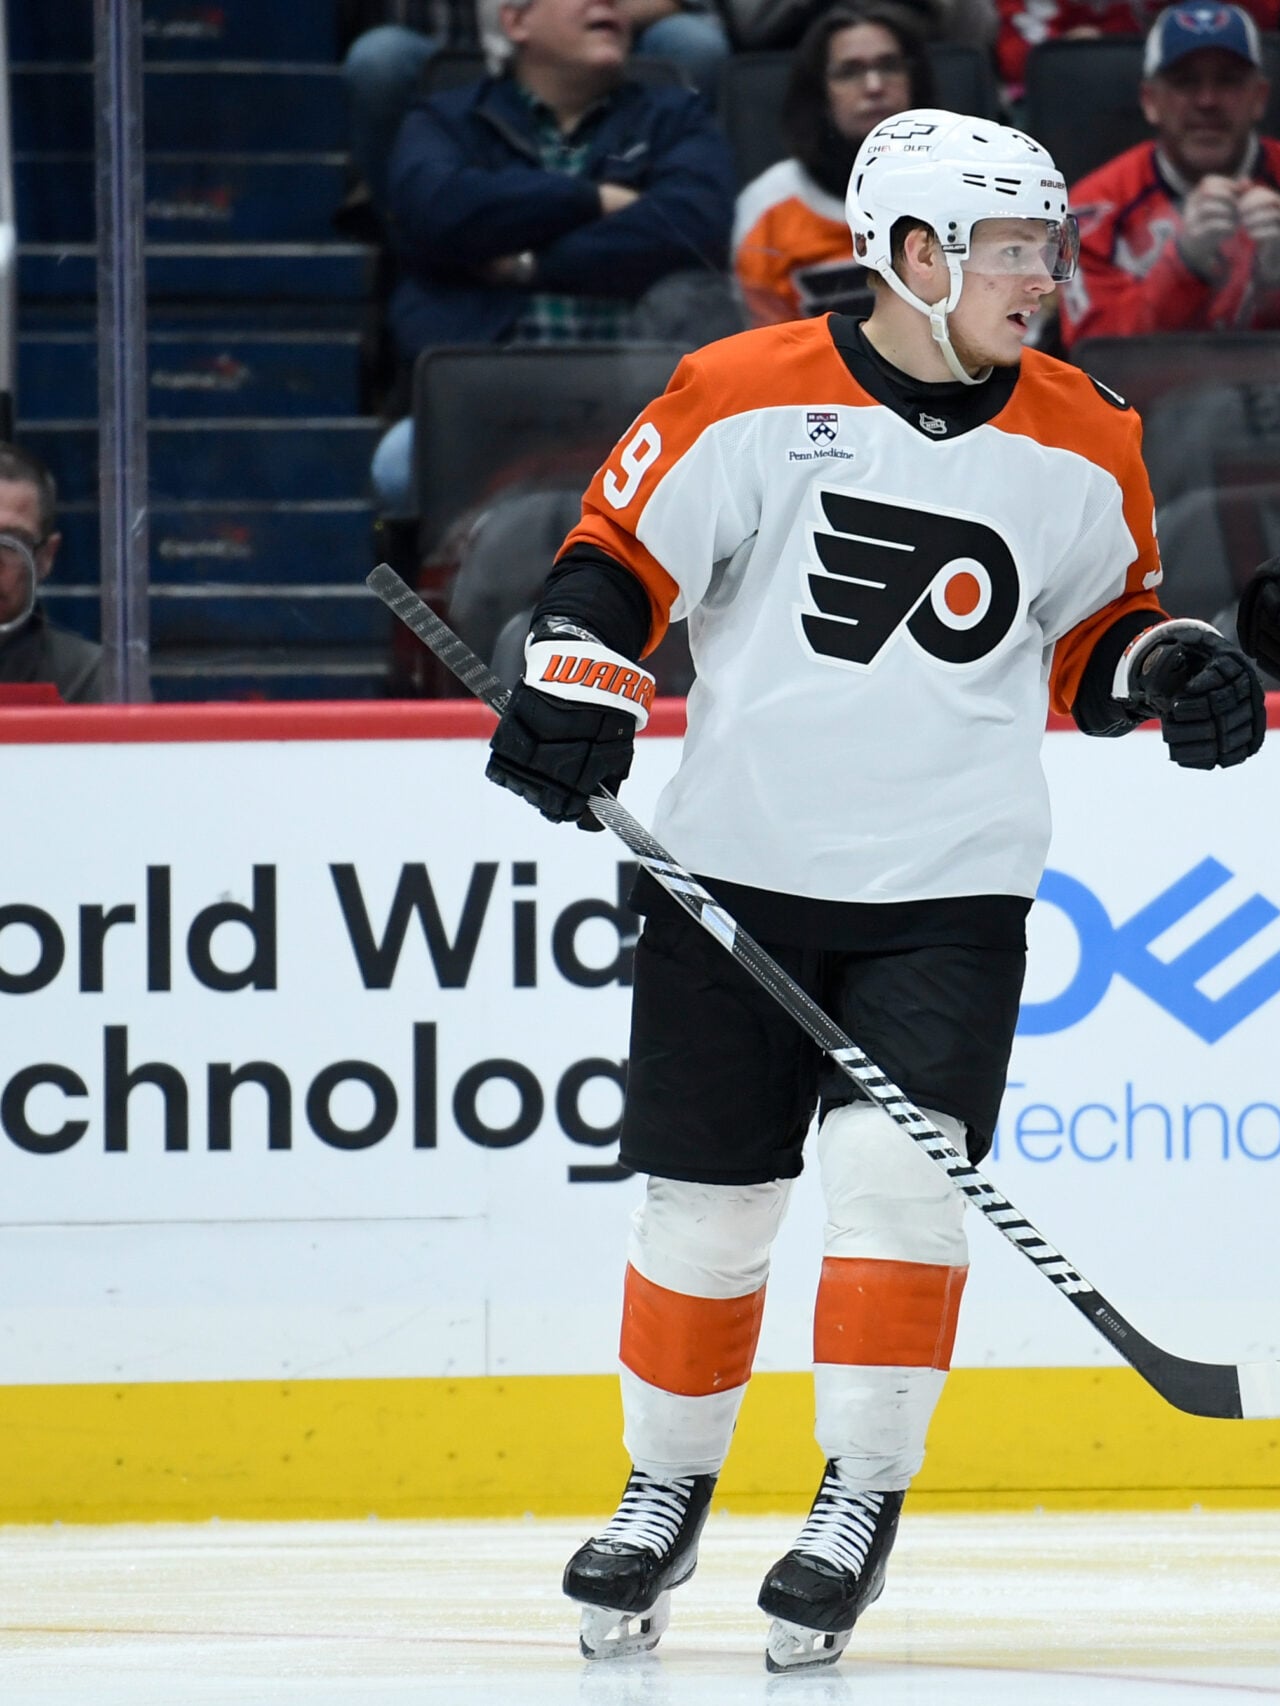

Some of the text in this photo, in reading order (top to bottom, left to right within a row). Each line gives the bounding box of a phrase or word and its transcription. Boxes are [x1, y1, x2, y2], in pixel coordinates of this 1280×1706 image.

[867, 144, 933, 154] CHEOLET
[788, 447, 855, 462] Penn Medicine
